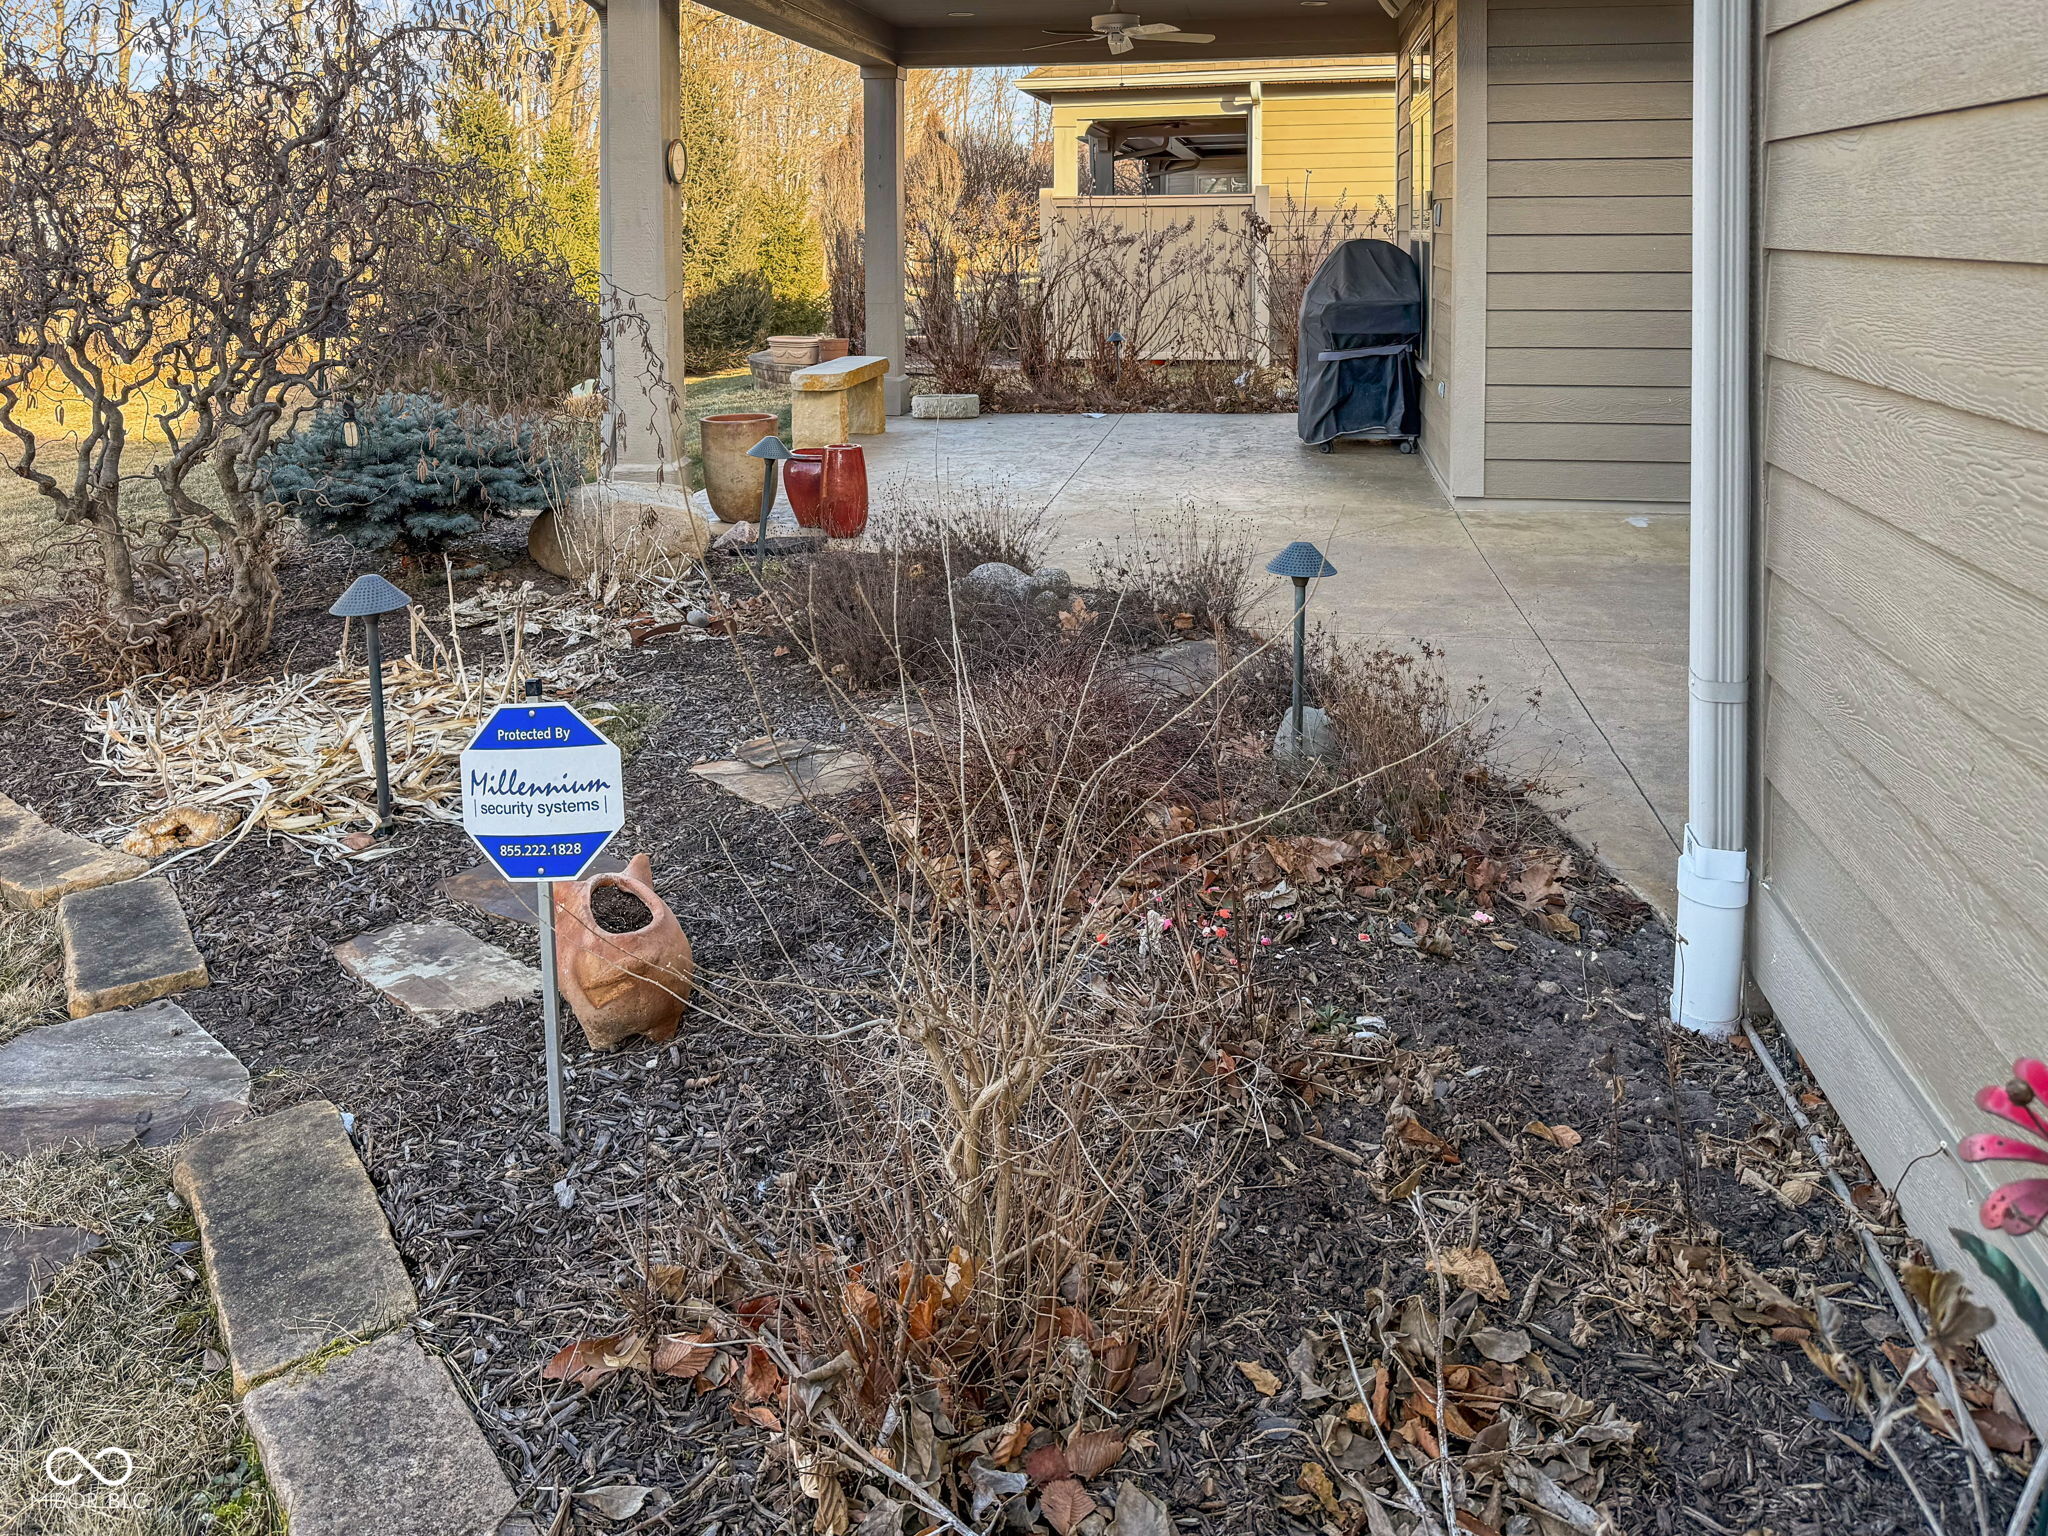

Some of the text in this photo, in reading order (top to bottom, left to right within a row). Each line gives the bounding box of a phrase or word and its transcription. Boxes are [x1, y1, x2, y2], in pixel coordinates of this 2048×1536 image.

[497, 727, 571, 742] Protected By
[471, 769, 610, 797] Millennium
[480, 799, 600, 817] security systems
[500, 843, 582, 857] 855.222.1828
